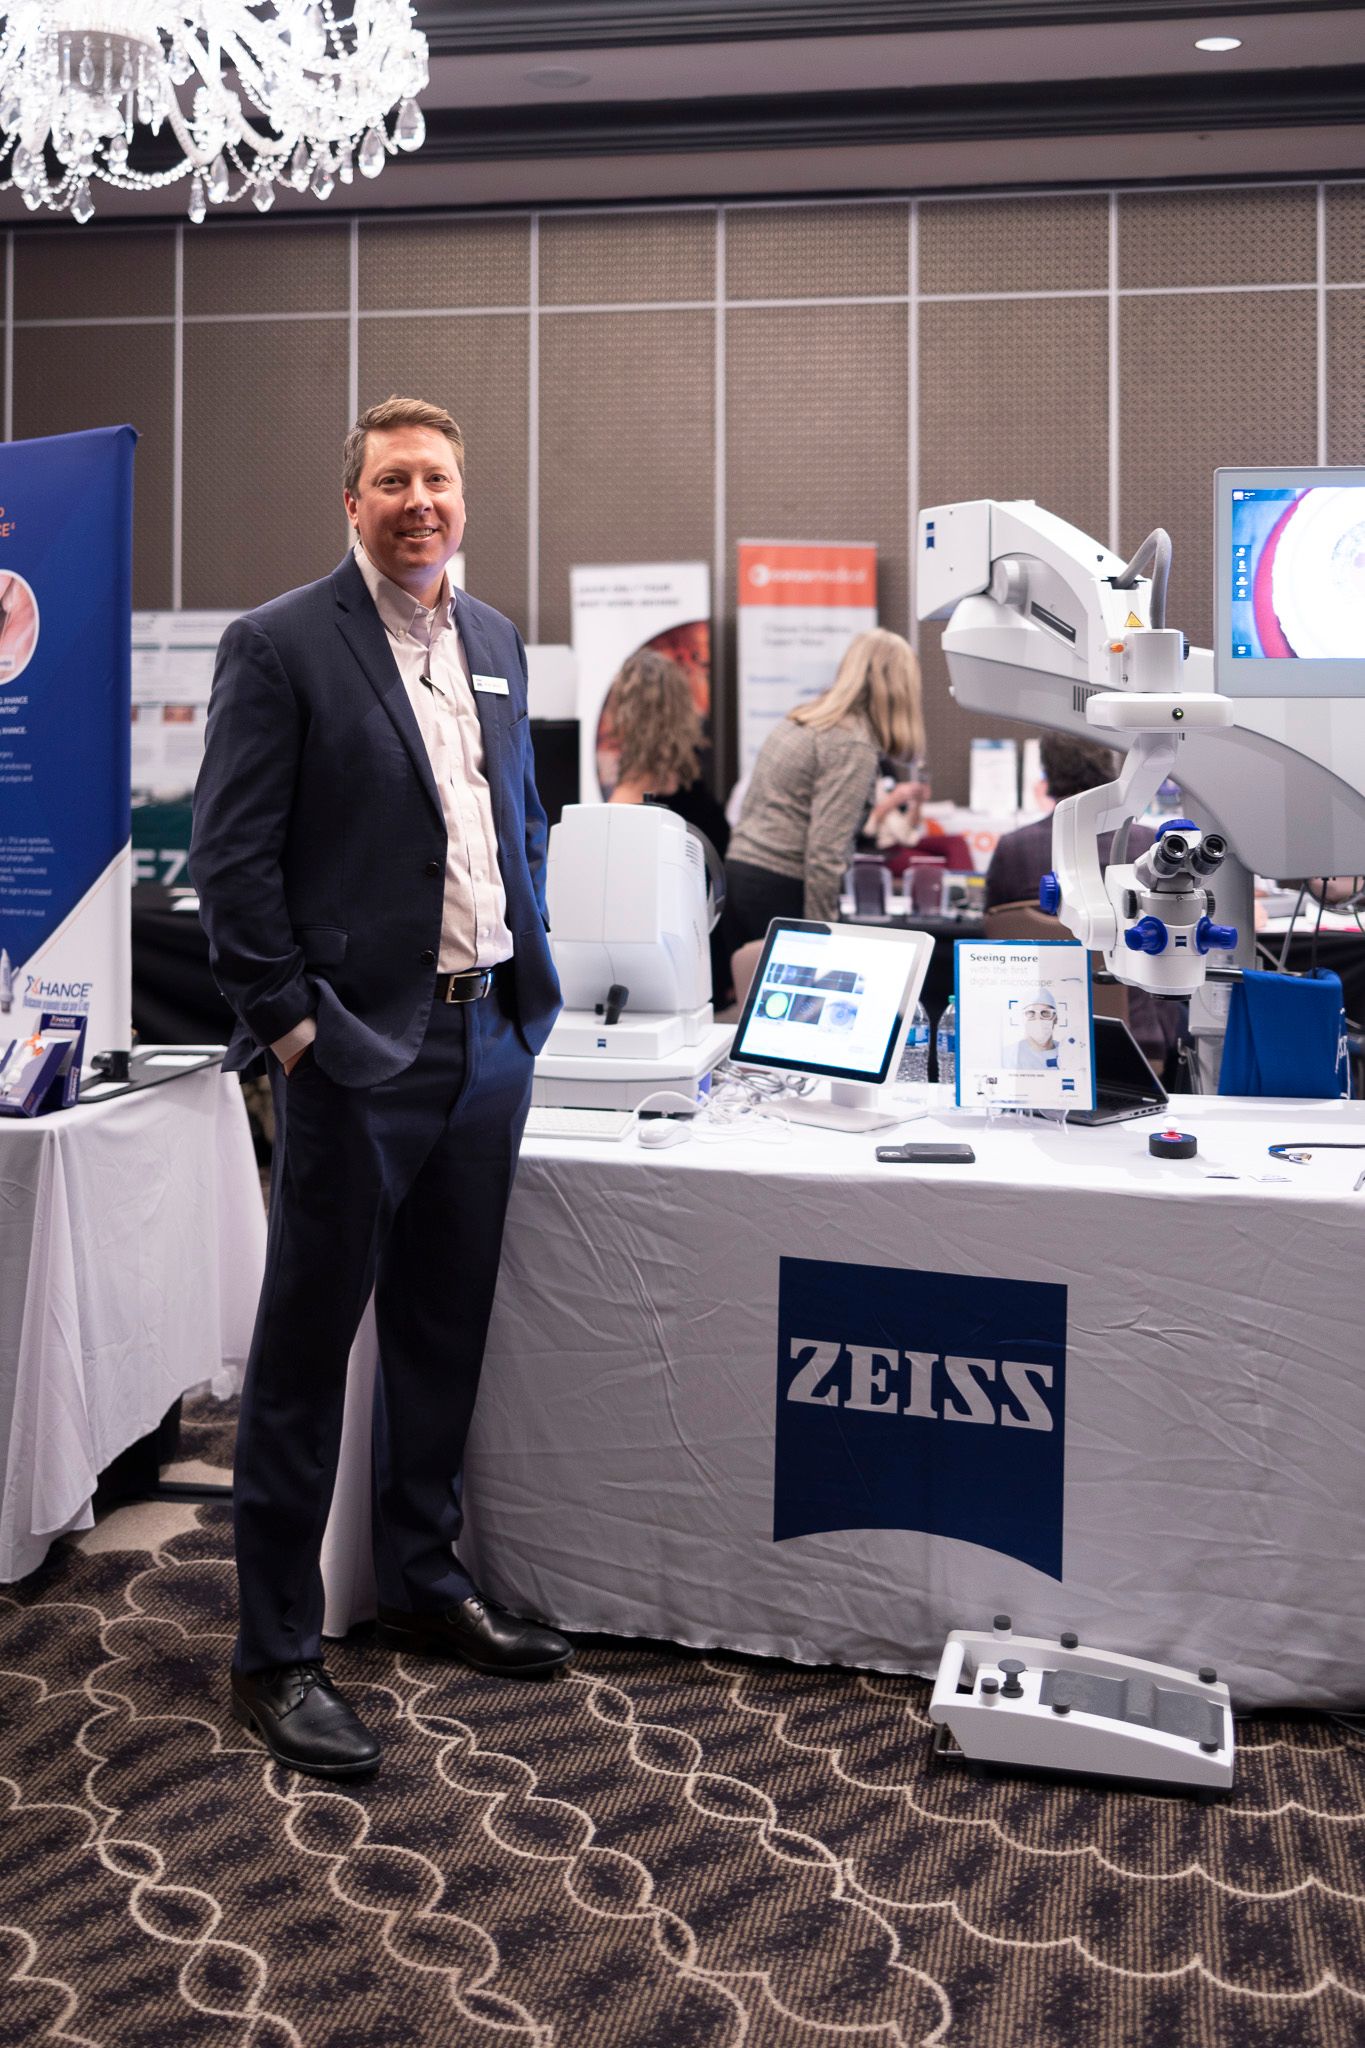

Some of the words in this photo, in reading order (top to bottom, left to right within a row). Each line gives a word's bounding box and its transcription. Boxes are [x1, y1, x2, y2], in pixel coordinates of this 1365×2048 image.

[970, 953, 1006, 964] Seeing
[1010, 955, 1039, 963] more
[787, 1337, 1054, 1432] ZEISS
